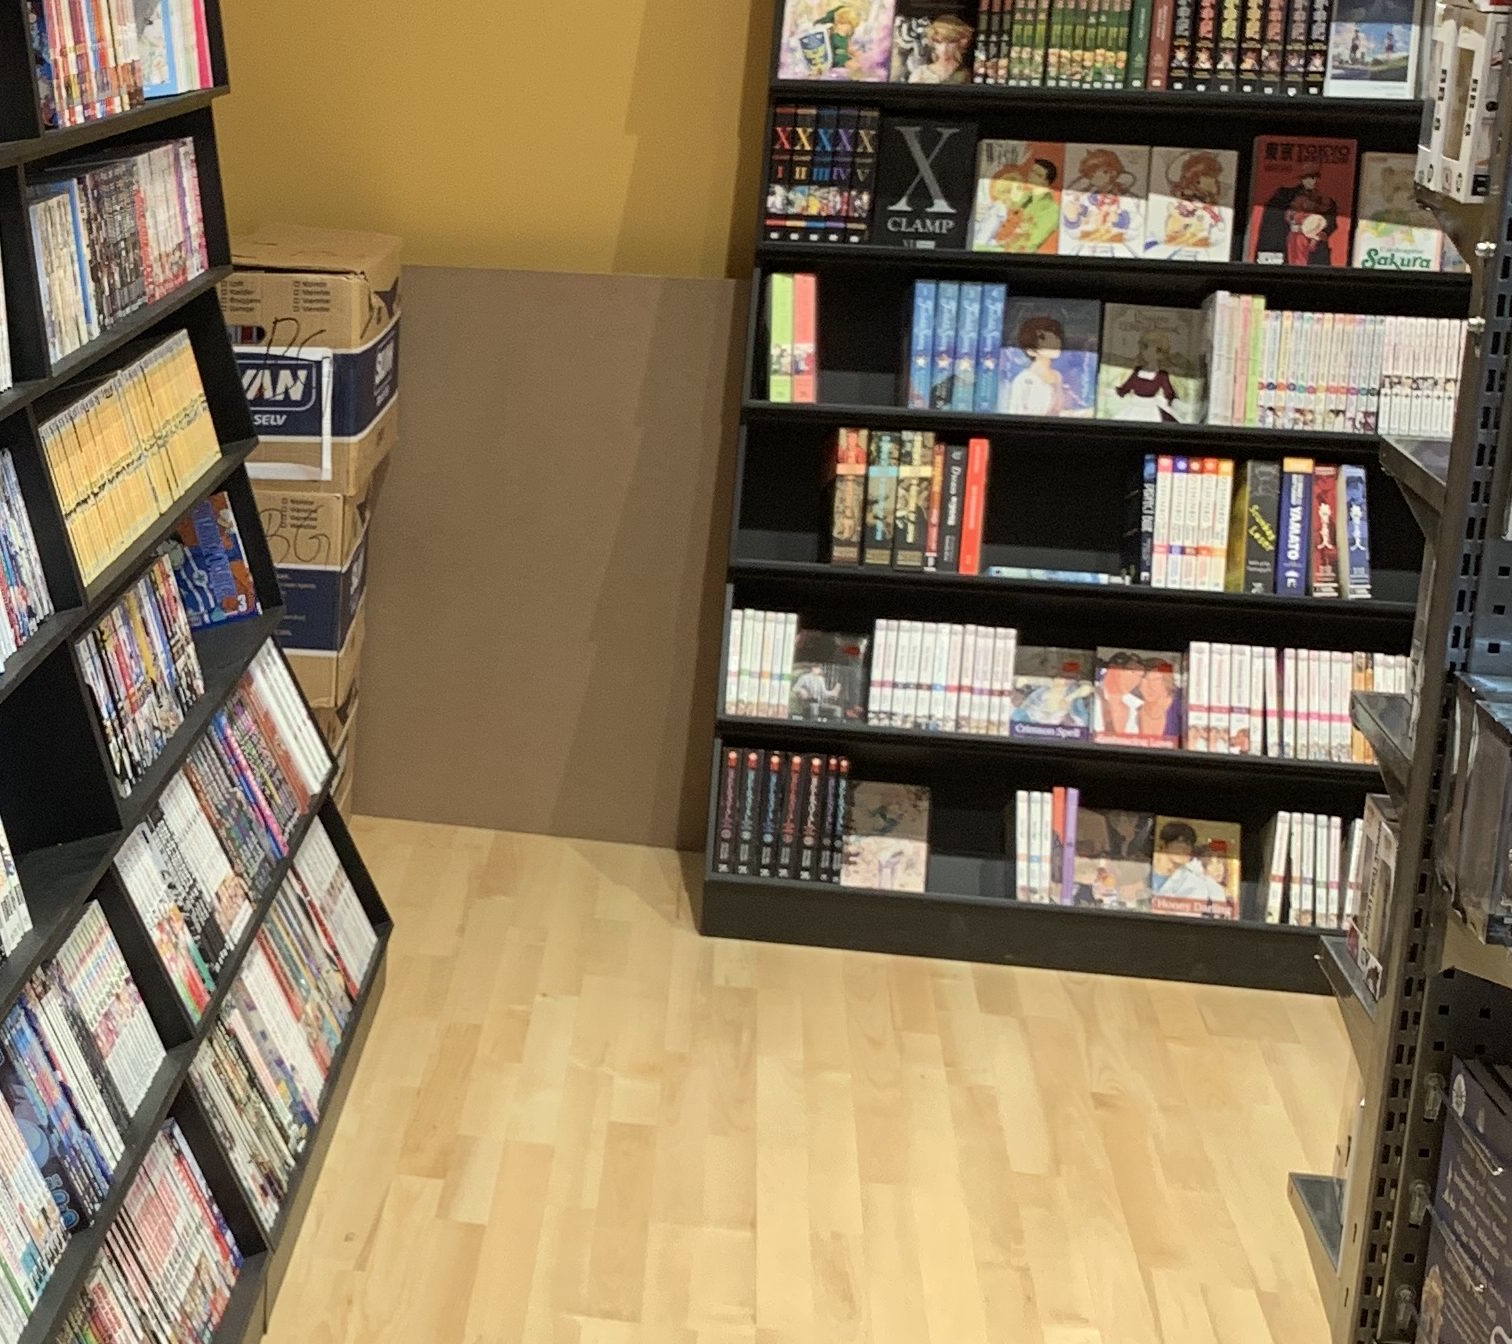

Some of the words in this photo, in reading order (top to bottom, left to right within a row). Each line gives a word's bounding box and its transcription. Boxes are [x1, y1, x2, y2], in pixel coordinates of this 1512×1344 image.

[774, 127, 793, 149] X
[1297, 143, 1352, 156] TOKYO
[888, 126, 960, 213] X
[888, 217, 955, 233] CLAMP
[1361, 248, 1432, 270] Sakura
[253, 414, 287, 425] SELV
[1287, 506, 1303, 561] YAMATO
[1015, 723, 1057, 736] Crimson
[1058, 726, 1081, 739] Spell
